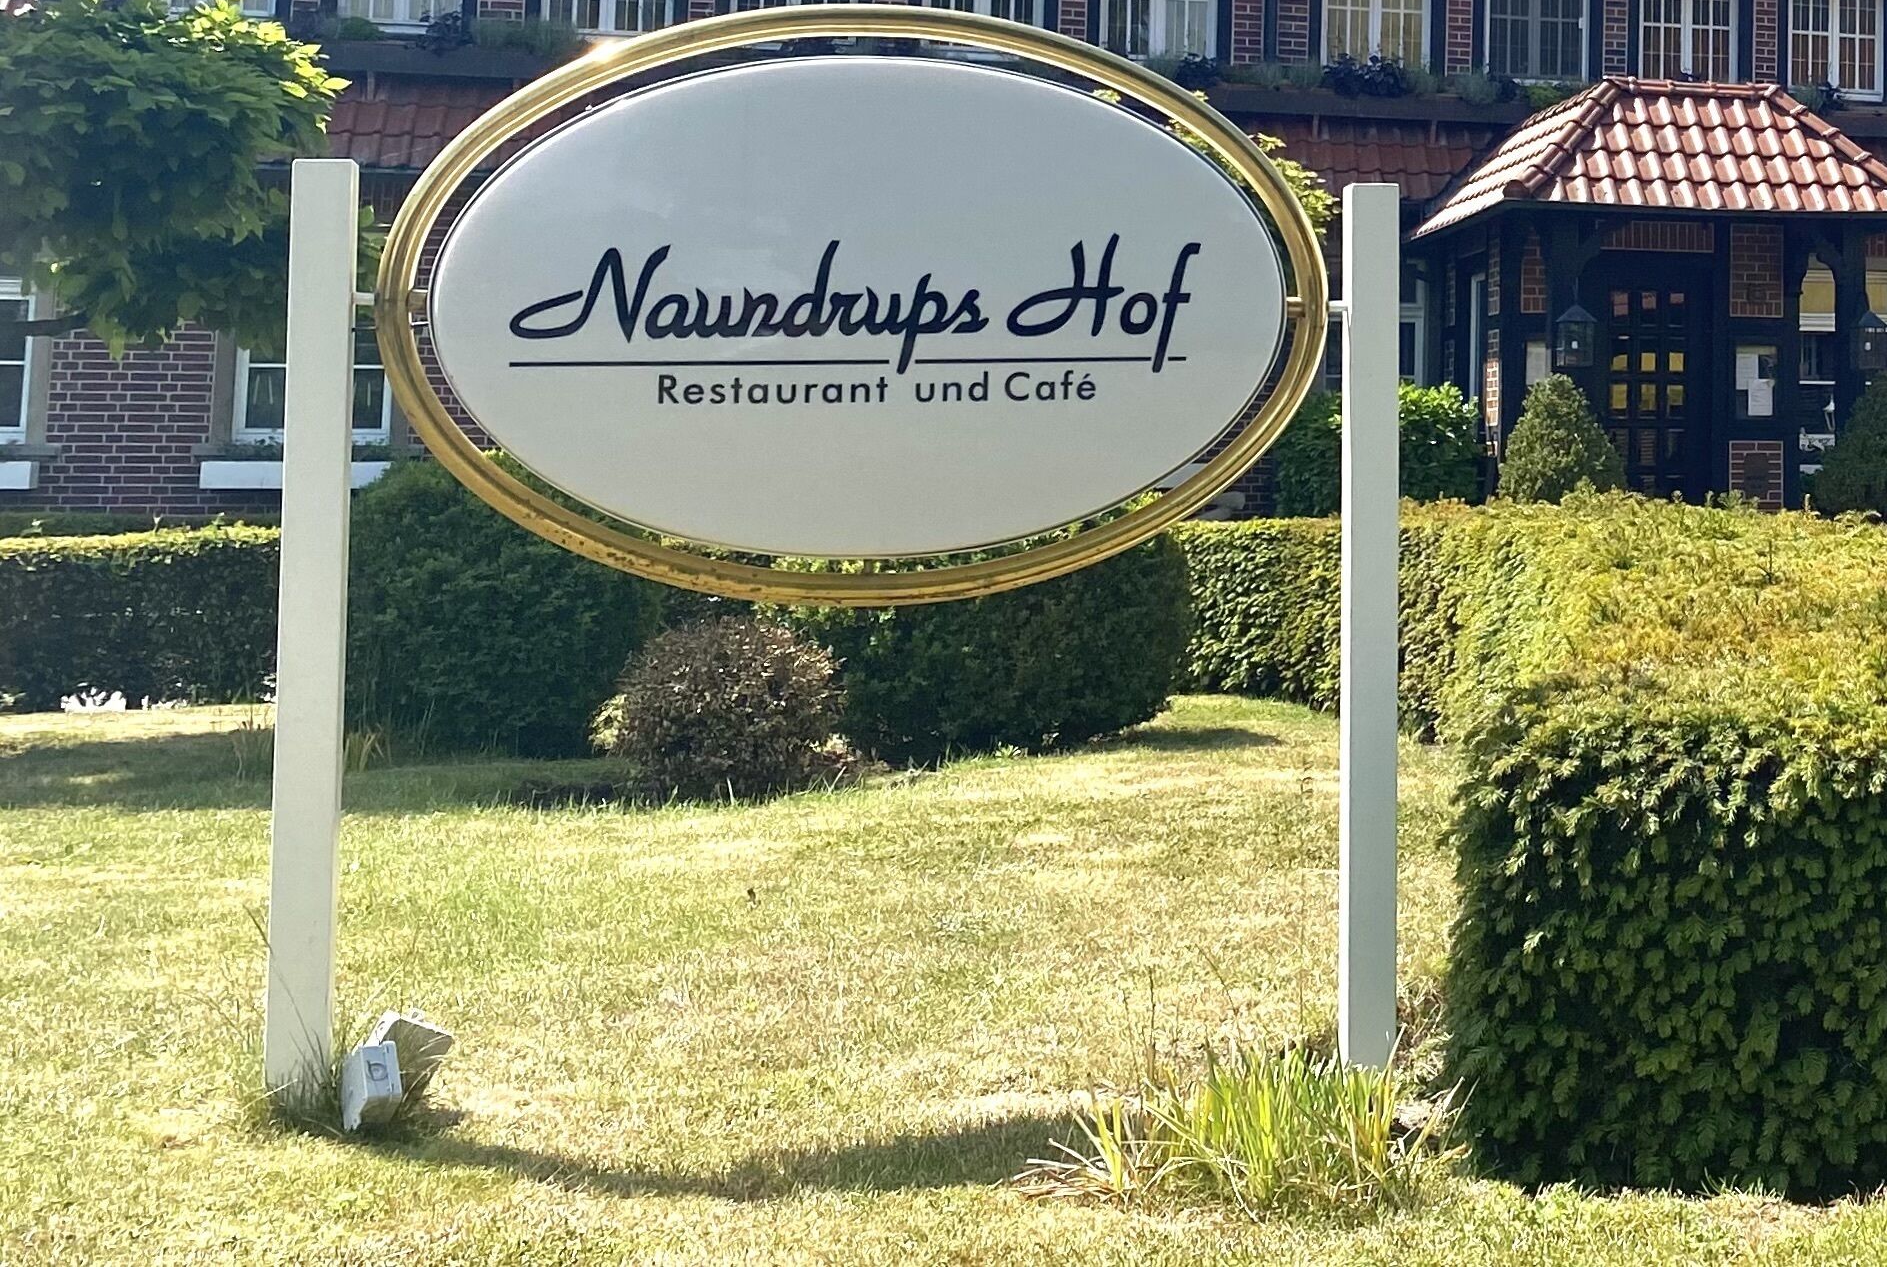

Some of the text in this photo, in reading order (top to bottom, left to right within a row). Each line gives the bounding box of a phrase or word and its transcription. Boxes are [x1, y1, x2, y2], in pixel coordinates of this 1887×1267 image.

[508, 232, 1202, 375] Naundrups Hof
[658, 368, 1097, 405] Restaurant und Café
